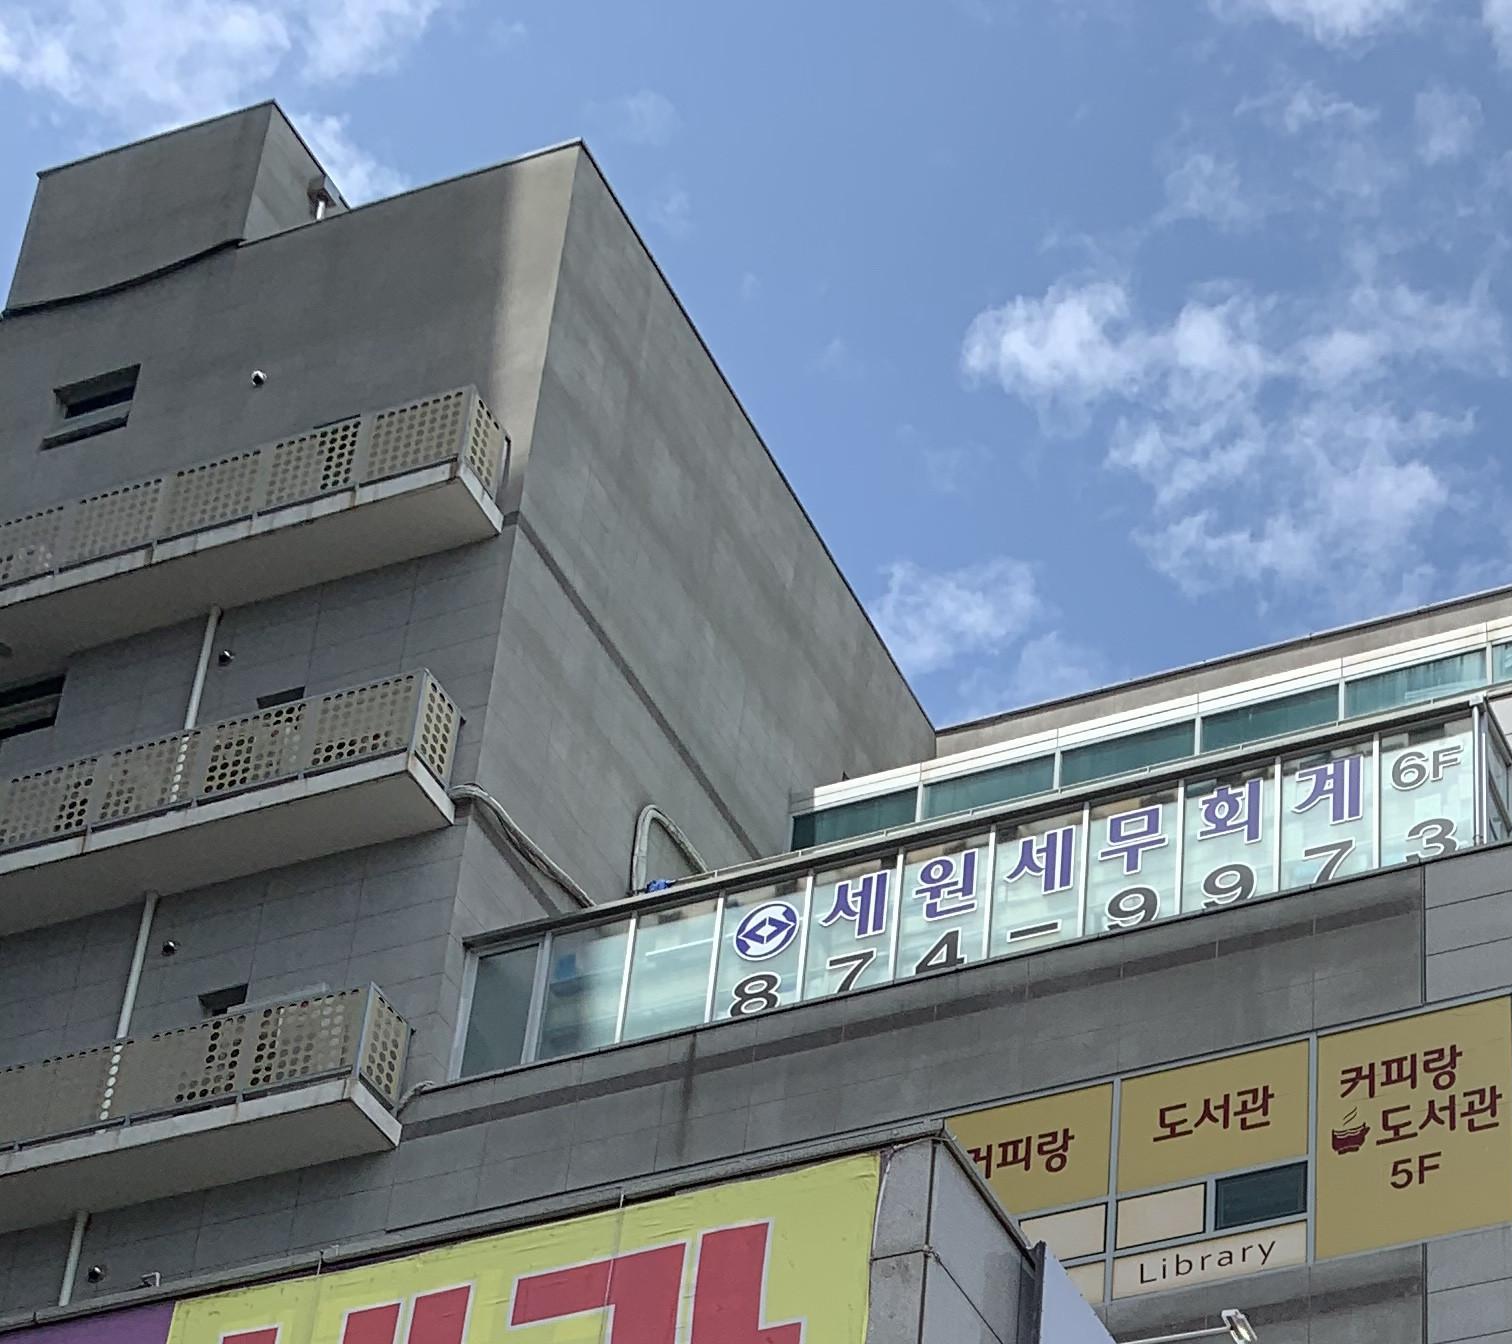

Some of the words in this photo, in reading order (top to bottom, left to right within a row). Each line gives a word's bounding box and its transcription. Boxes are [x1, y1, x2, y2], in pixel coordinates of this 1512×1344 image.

[819, 753, 1364, 940] 세원세무회계
[1389, 744, 1463, 791] 6F
[1339, 1044, 1463, 1100] 커피랑
[1152, 1084, 1275, 1143] 도서관
[1375, 1085, 1503, 1148] 도서관
[1390, 1152, 1442, 1190] 5F
[1139, 1238, 1277, 1285] Library
